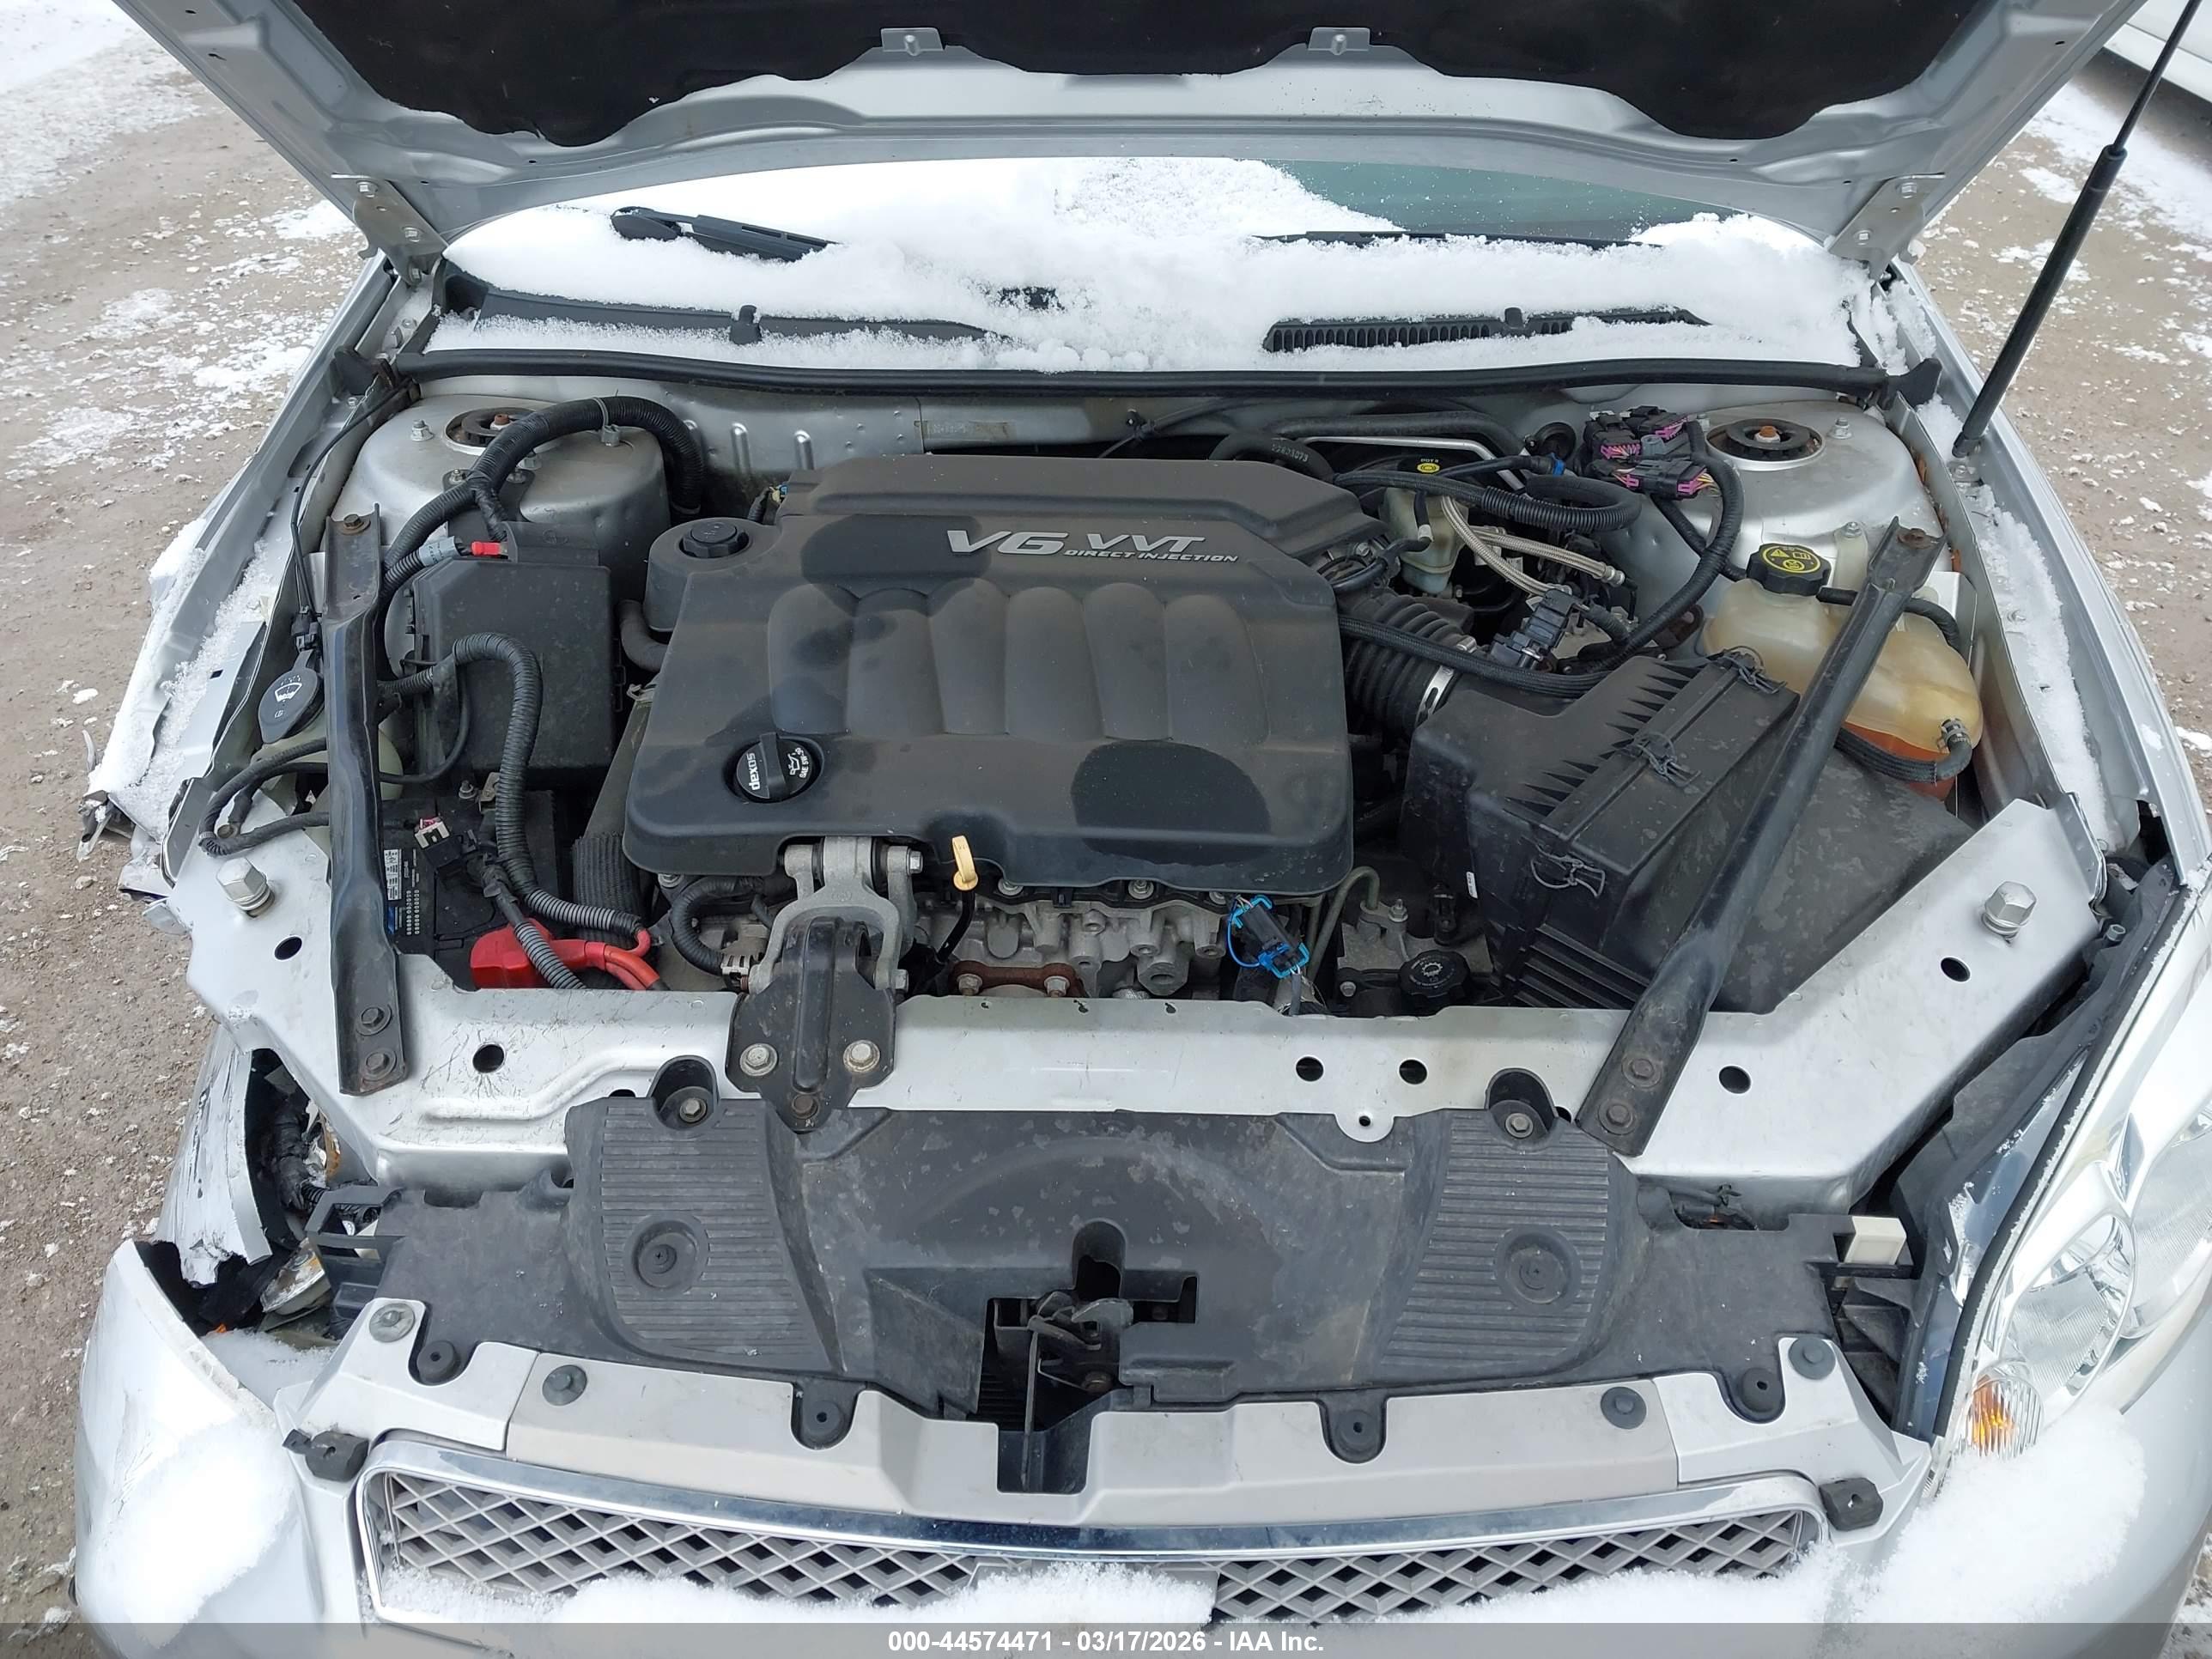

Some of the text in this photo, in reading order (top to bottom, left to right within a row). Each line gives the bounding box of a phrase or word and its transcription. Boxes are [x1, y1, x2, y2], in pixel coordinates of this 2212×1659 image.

[946, 529, 1206, 556] V6 VVT
[1063, 549, 1239, 562] DIRECT INJECTION
[746, 752, 761, 791] dexos
[799, 765, 809, 778] SAE
